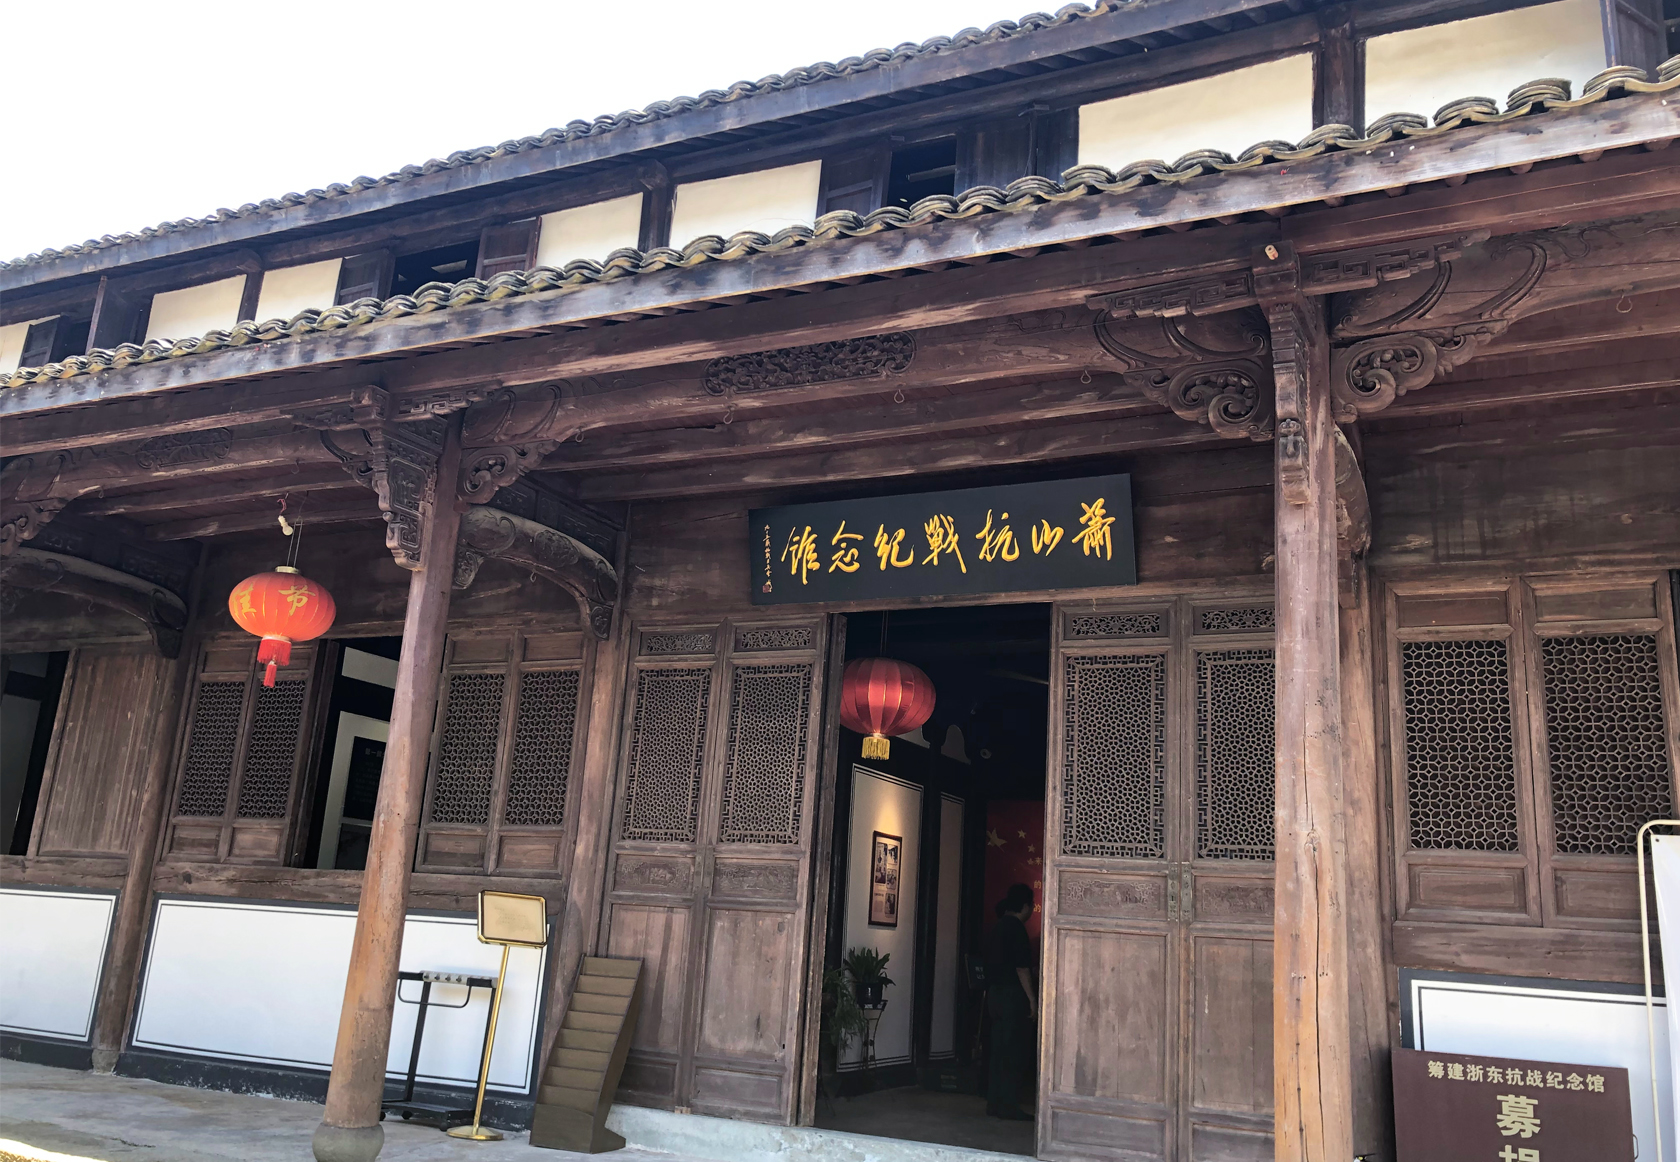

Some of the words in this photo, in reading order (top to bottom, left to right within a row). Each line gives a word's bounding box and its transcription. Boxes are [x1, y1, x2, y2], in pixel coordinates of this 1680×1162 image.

[1427, 1060, 1605, 1093] 筹建浙东抗战纪念馆
